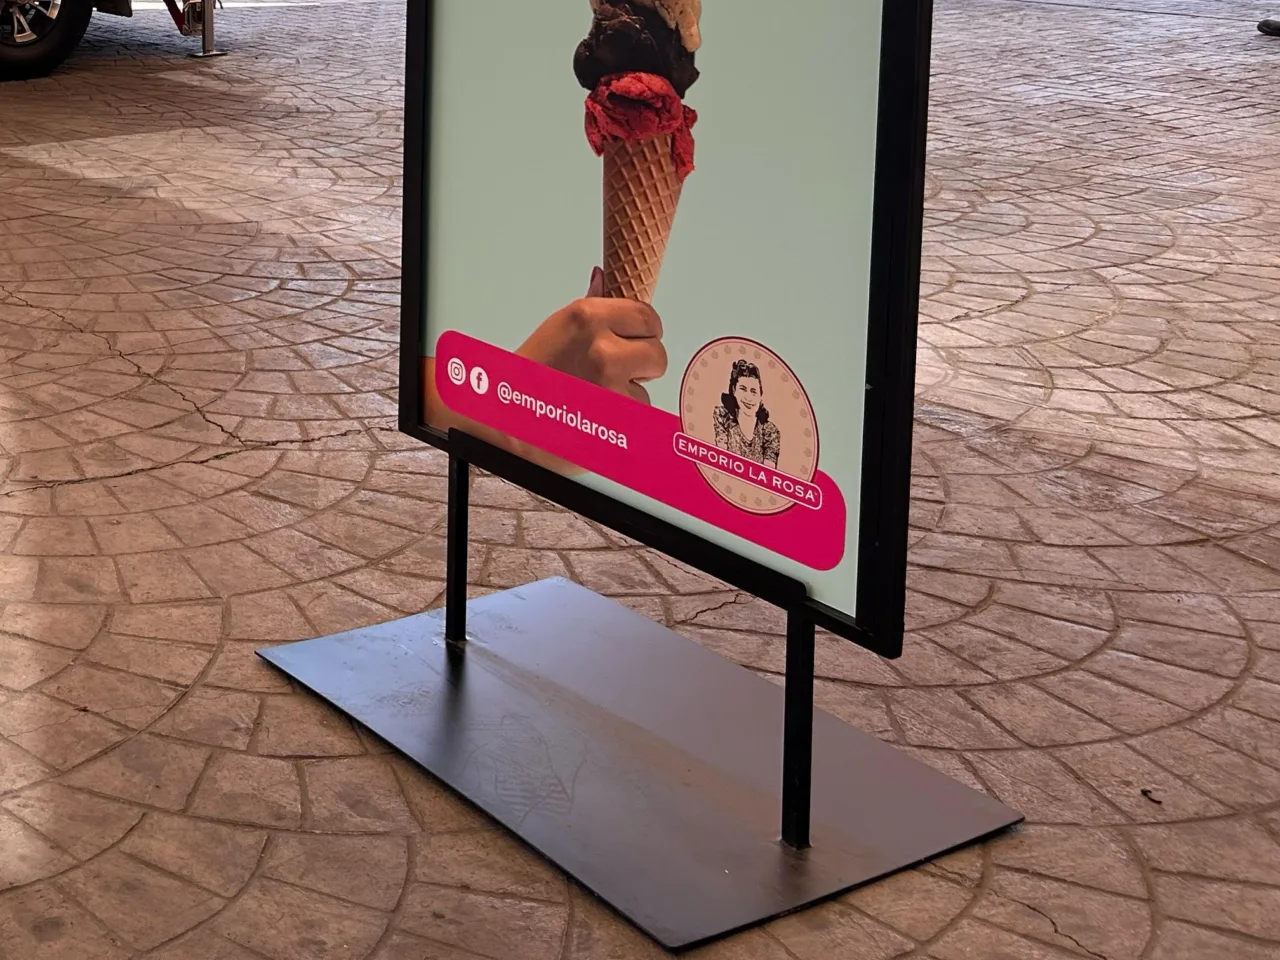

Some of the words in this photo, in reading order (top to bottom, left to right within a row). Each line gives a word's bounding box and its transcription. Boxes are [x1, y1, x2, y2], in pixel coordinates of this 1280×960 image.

[497, 381, 628, 450] @emporiolarosa
[678, 438, 744, 474] EMPORIO
[748, 466, 768, 484] LA
[772, 475, 816, 503] ROSA
